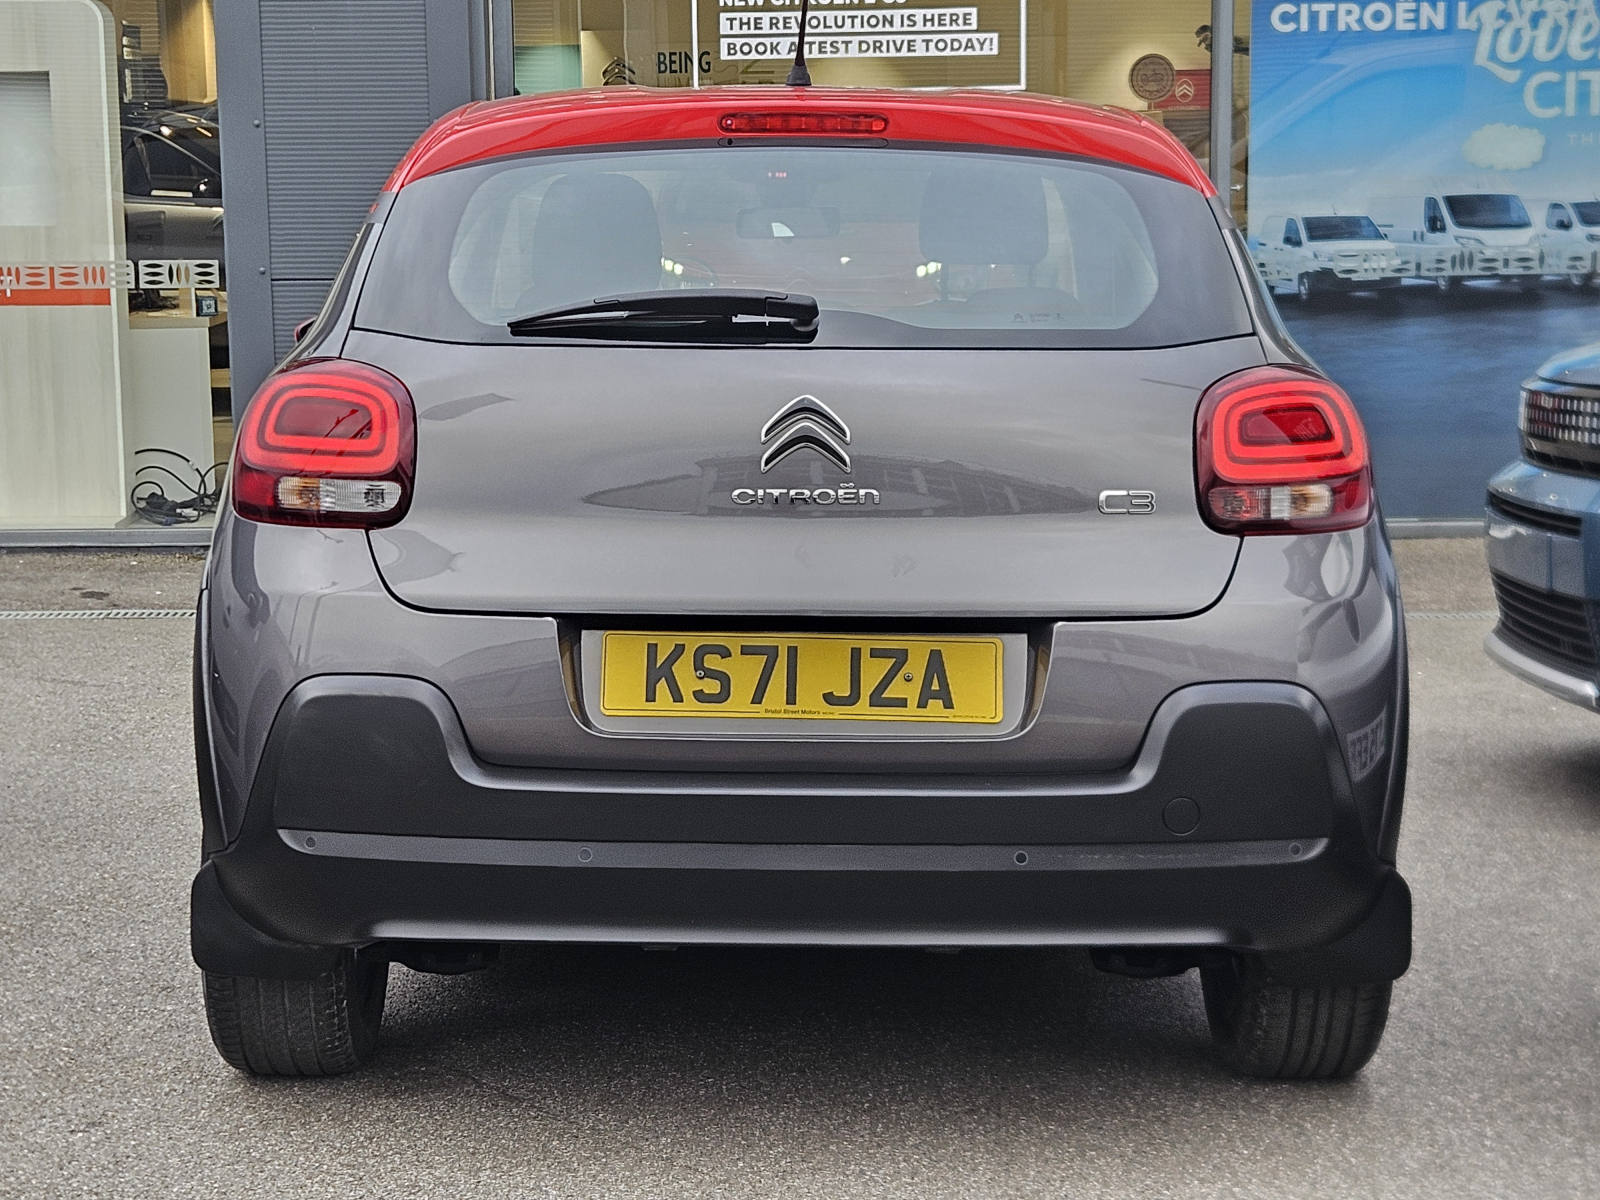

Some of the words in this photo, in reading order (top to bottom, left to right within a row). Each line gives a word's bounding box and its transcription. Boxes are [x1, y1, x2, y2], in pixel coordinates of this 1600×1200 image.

[726, 17, 764, 31] THE
[769, 14, 894, 30] REVOLUTION
[900, 14, 918, 28] IS
[923, 12, 973, 27] HERE
[1270, 0, 1445, 32] CITROËN
[727, 41, 782, 56] BOOK
[787, 41, 799, 55] A
[804, 40, 853, 55] TEST
[858, 39, 917, 54] DRIVE
[922, 37, 994, 53] TODAY!
[1466, 0, 1600, 83] Love
[657, 51, 711, 74] BEING
[1523, 70, 1600, 118] CIT
[1567, 132, 1600, 147] TH
[731, 482, 880, 505] CITROËN
[1098, 490, 1157, 515] C3
[645, 643, 799, 706] KS71
[822, 647, 955, 710] JZA
